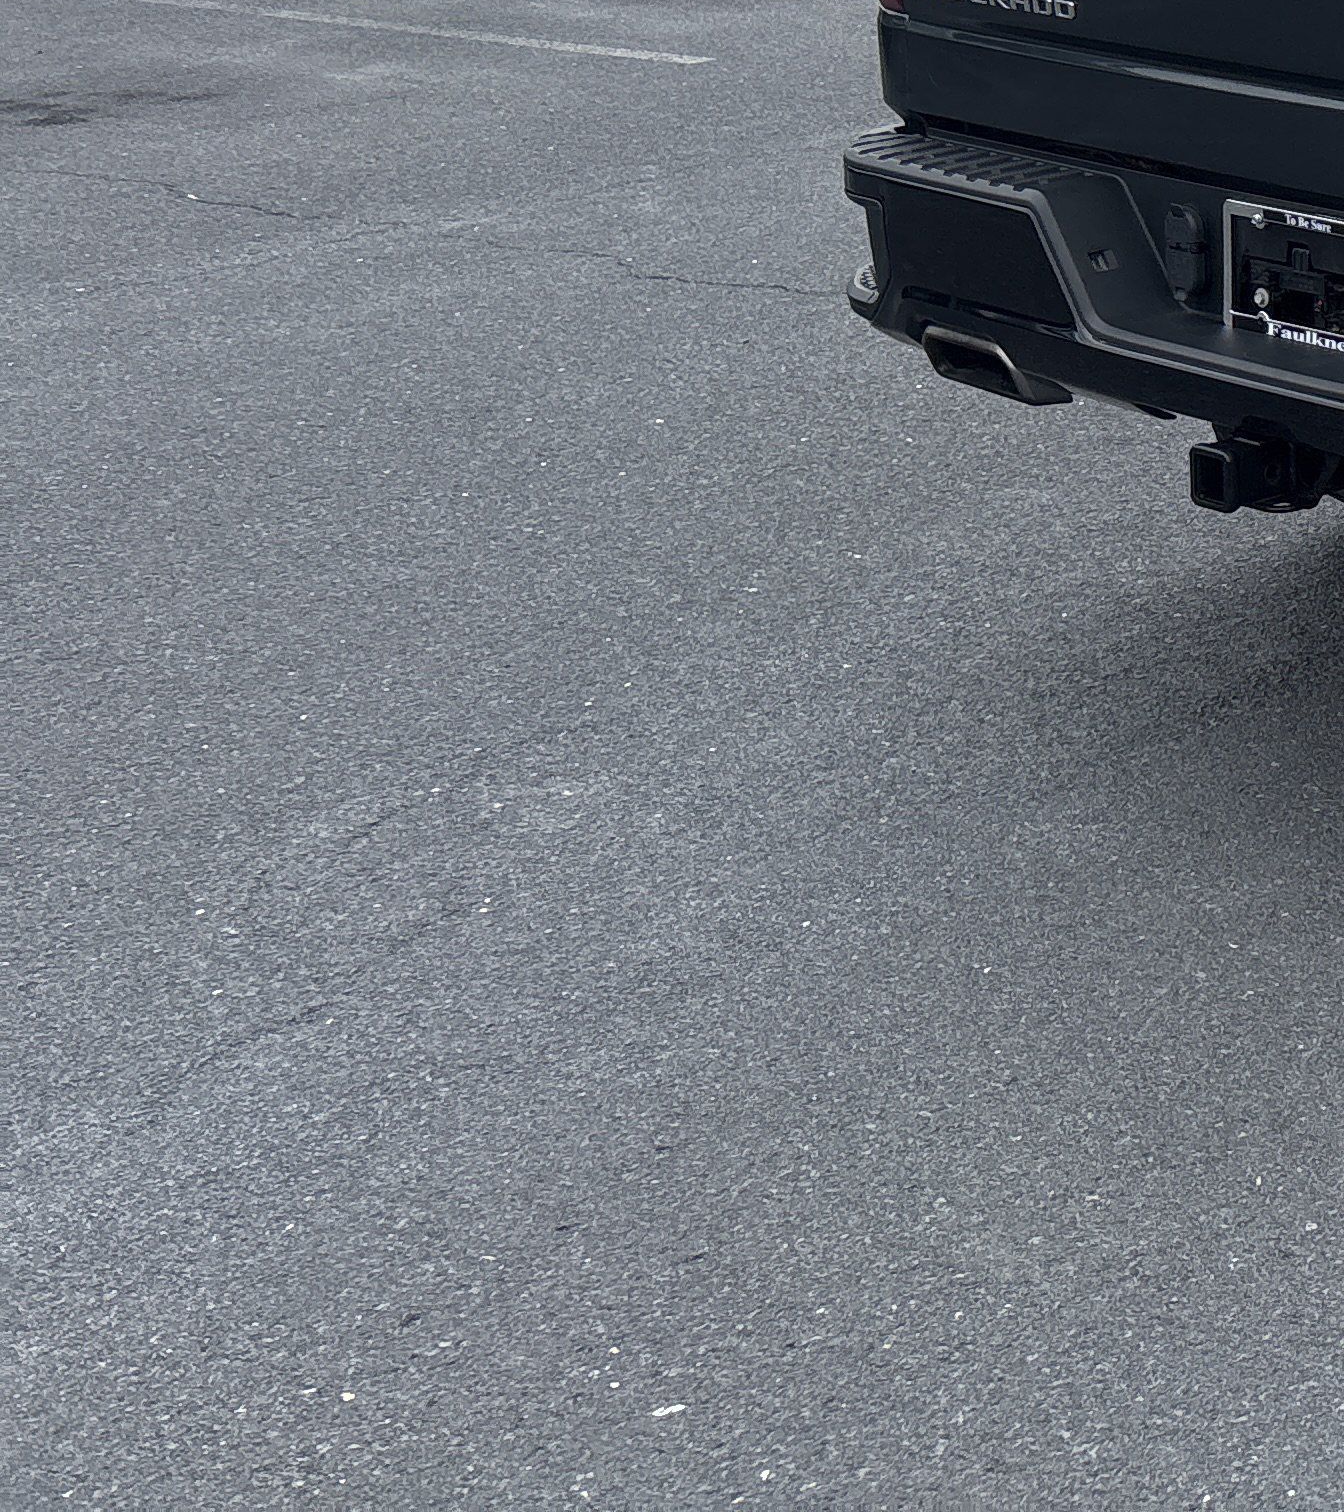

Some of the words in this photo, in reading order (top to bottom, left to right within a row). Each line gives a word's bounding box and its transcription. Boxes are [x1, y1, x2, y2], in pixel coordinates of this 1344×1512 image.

[1285, 214, 1296, 226] To
[1298, 217, 1310, 228] Be
[1310, 219, 1332, 234] Sure
